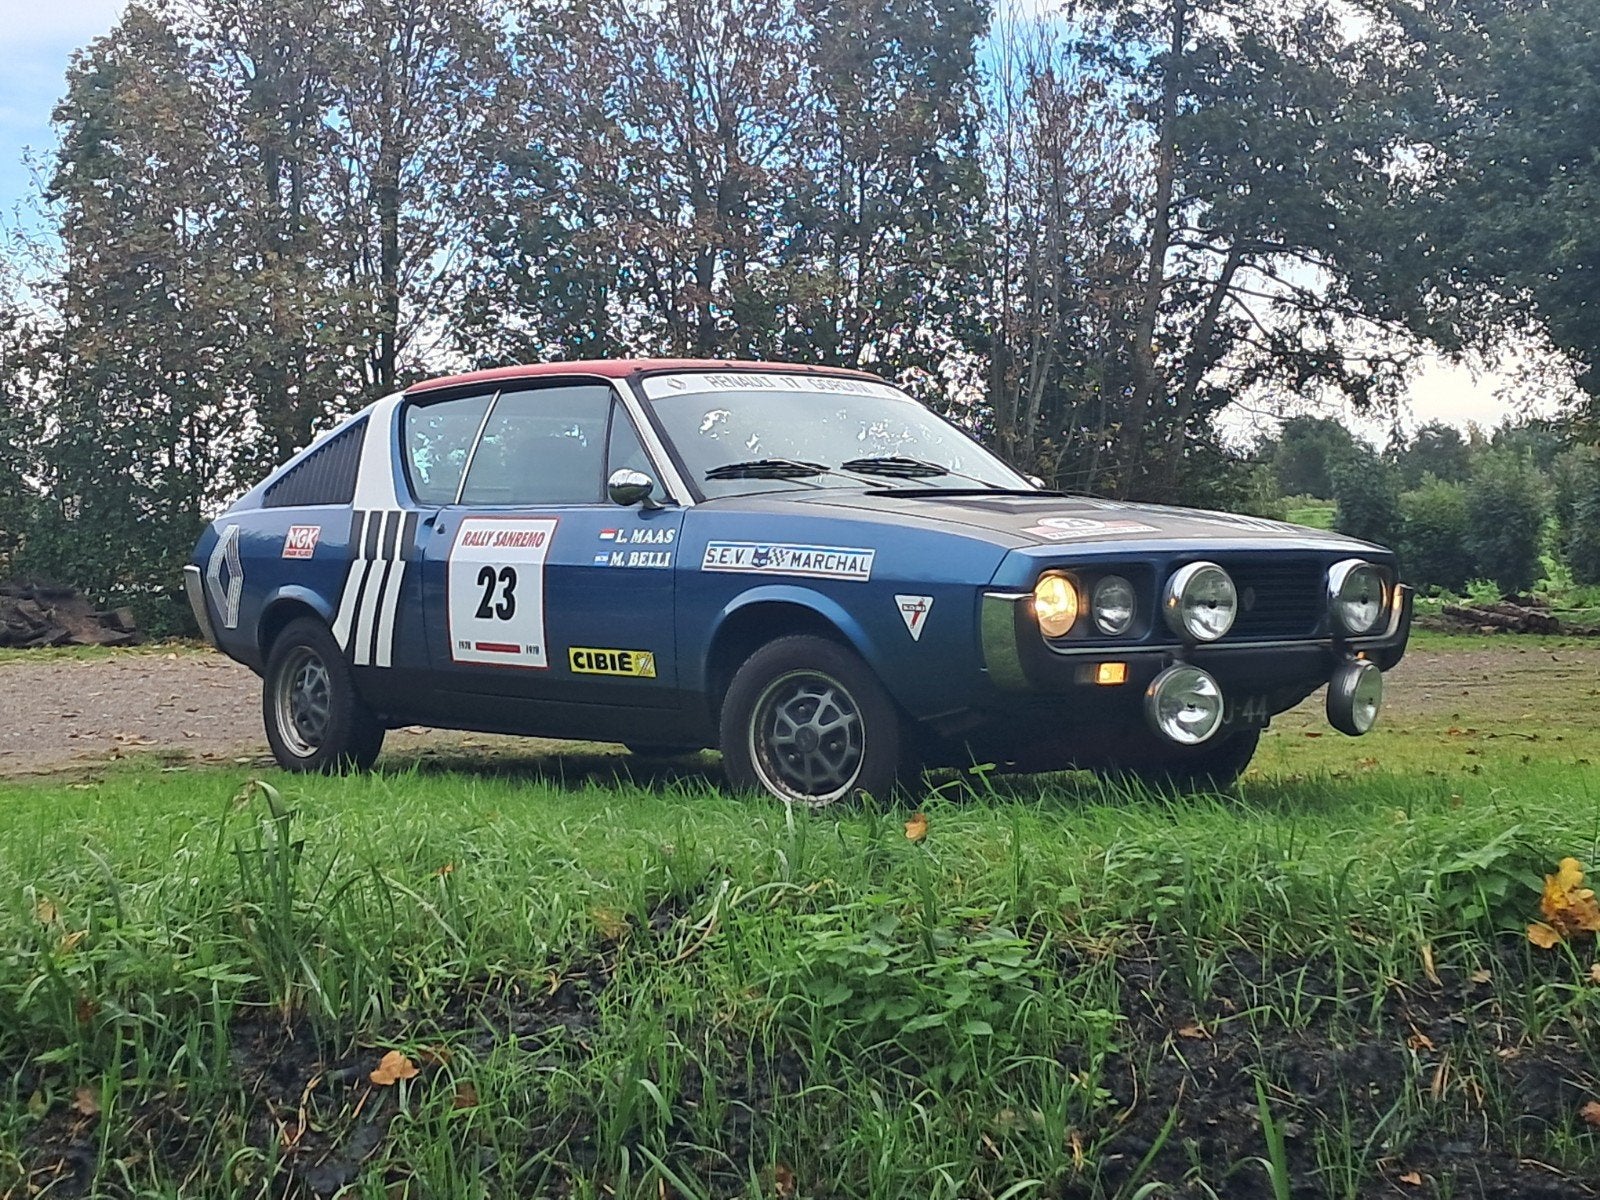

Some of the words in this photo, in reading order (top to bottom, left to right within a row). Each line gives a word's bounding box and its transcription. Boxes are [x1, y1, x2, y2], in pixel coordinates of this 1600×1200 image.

[703, 375, 777, 388] RENAULT
[779, 377, 801, 389] 17
[284, 528, 320, 549] NGK
[461, 531, 495, 547] RALLY
[493, 531, 546, 548] SANREMO
[615, 528, 628, 544] L.
[629, 528, 676, 544] MAAS
[609, 551, 626, 567] M.
[627, 551, 672, 567] BELLI
[705, 547, 746, 565] S.E.V.
[789, 552, 869, 573] MARCHAL
[474, 565, 517, 621] 23
[573, 651, 633, 672] CIBIE
